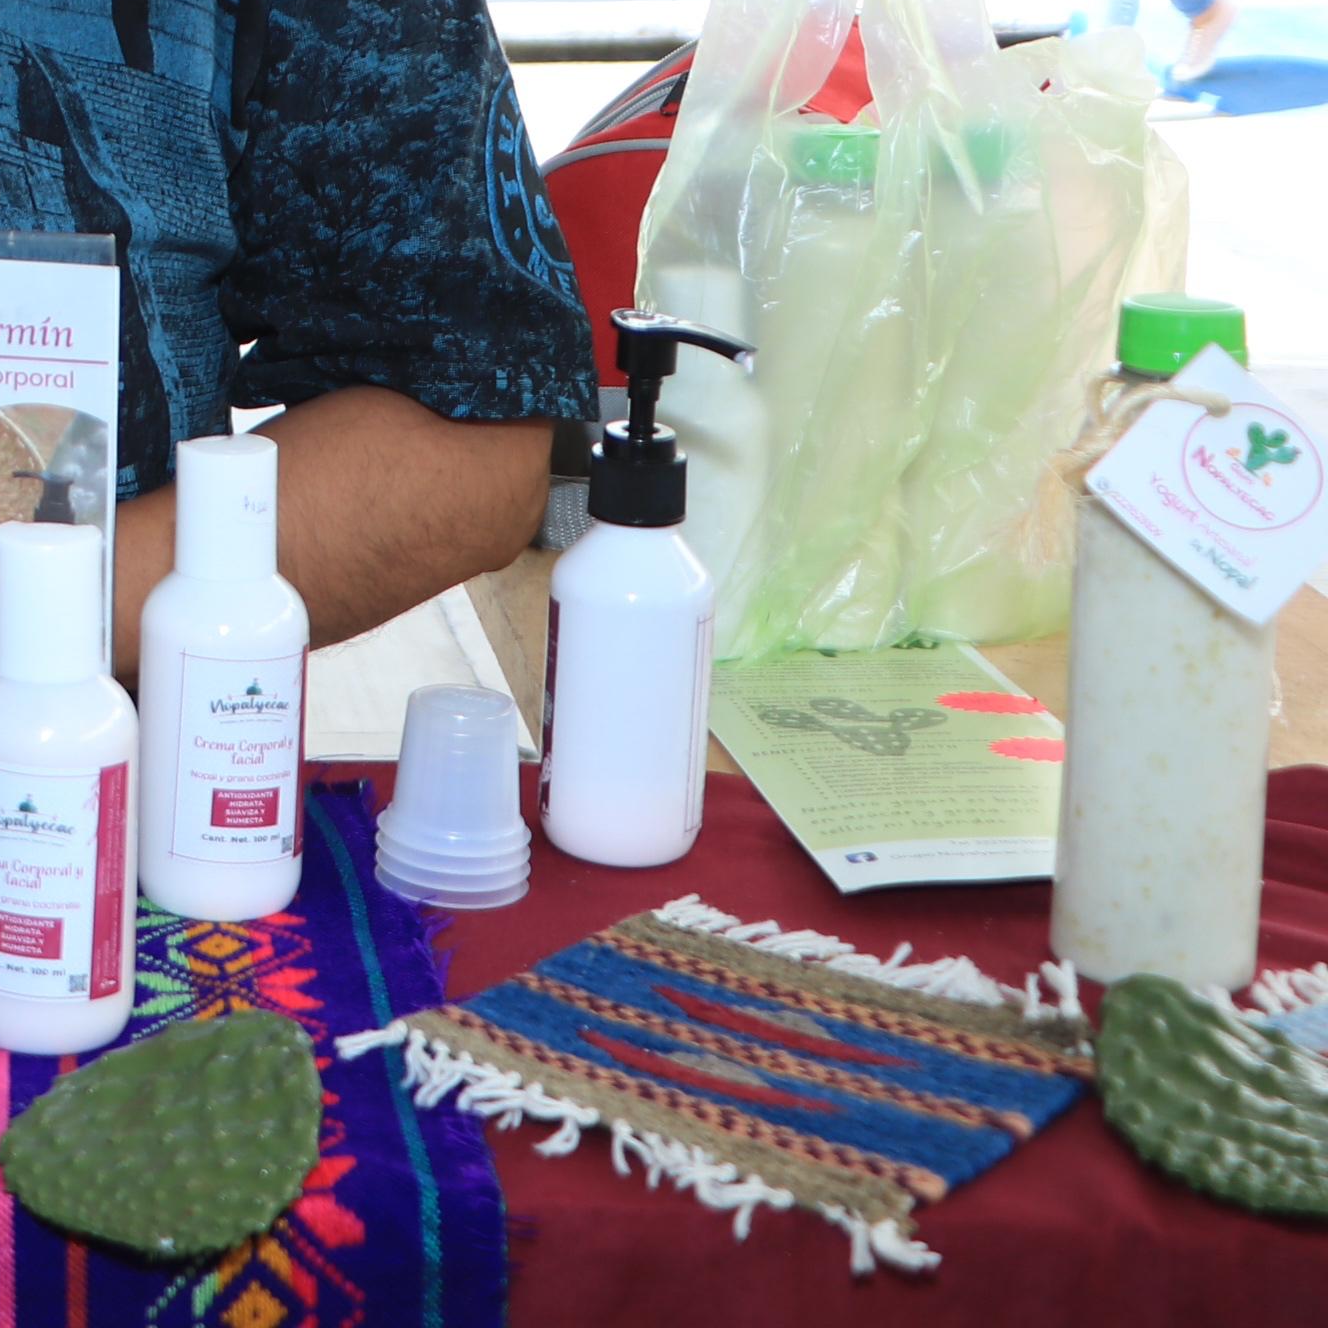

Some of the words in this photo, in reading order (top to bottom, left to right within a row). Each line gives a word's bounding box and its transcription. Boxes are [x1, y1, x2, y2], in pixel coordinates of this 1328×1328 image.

[1206, 547, 1259, 589] Nopal
[194, 735, 235, 752] Crema
[12, 859, 73, 880] Corporal
